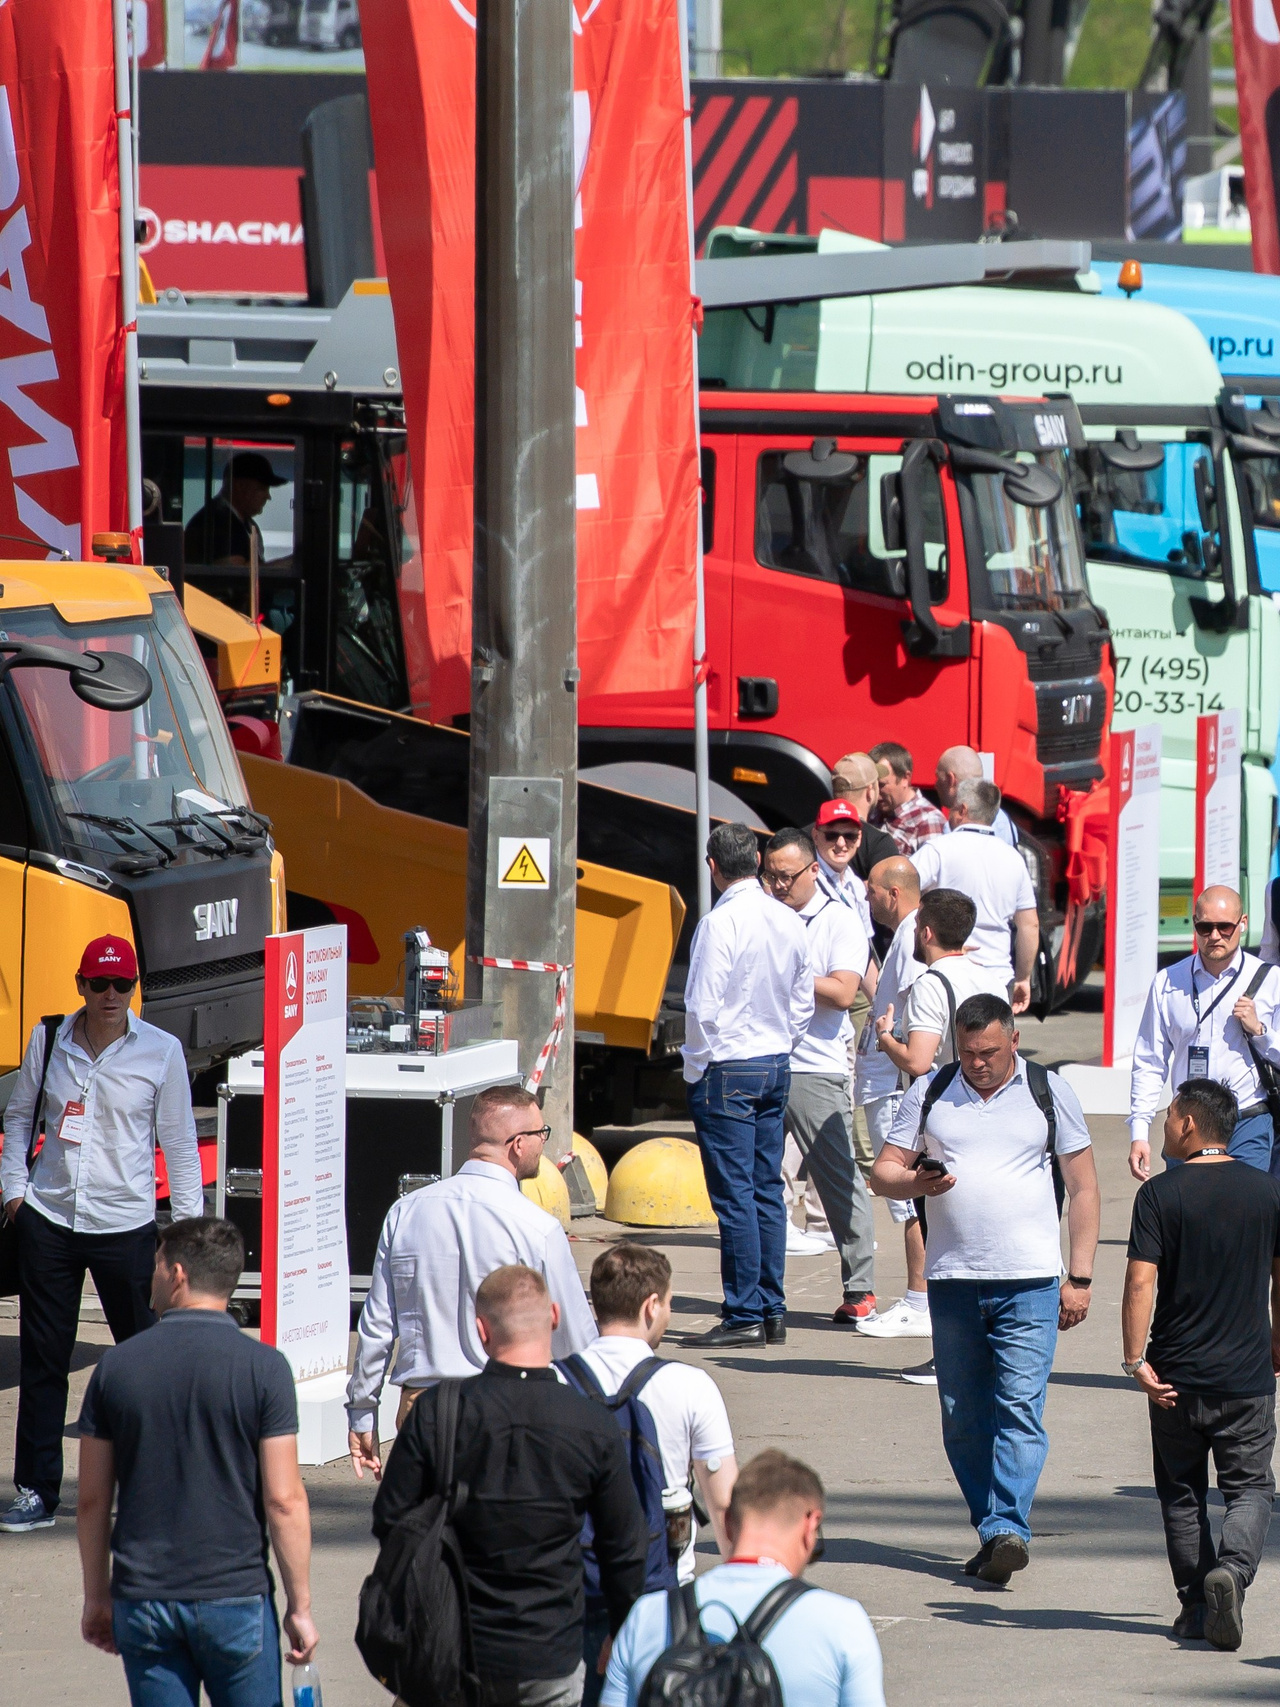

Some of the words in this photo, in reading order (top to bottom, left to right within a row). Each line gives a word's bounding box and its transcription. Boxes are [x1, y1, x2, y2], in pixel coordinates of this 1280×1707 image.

[163, 219, 304, 246] SHACMA
[1210, 336, 1274, 361] p.ru
[906, 355, 1123, 389] odin-group.ru
[1109, 631, 1172, 639] нтакты
[1117, 657, 1132, 678] 7
[1141, 655, 1209, 685] (495)
[1113, 690, 1225, 714] 20-33-14
[193, 898, 239, 941] SANY
[98, 955, 122, 963] SANY
[284, 1003, 298, 1019] SANY
